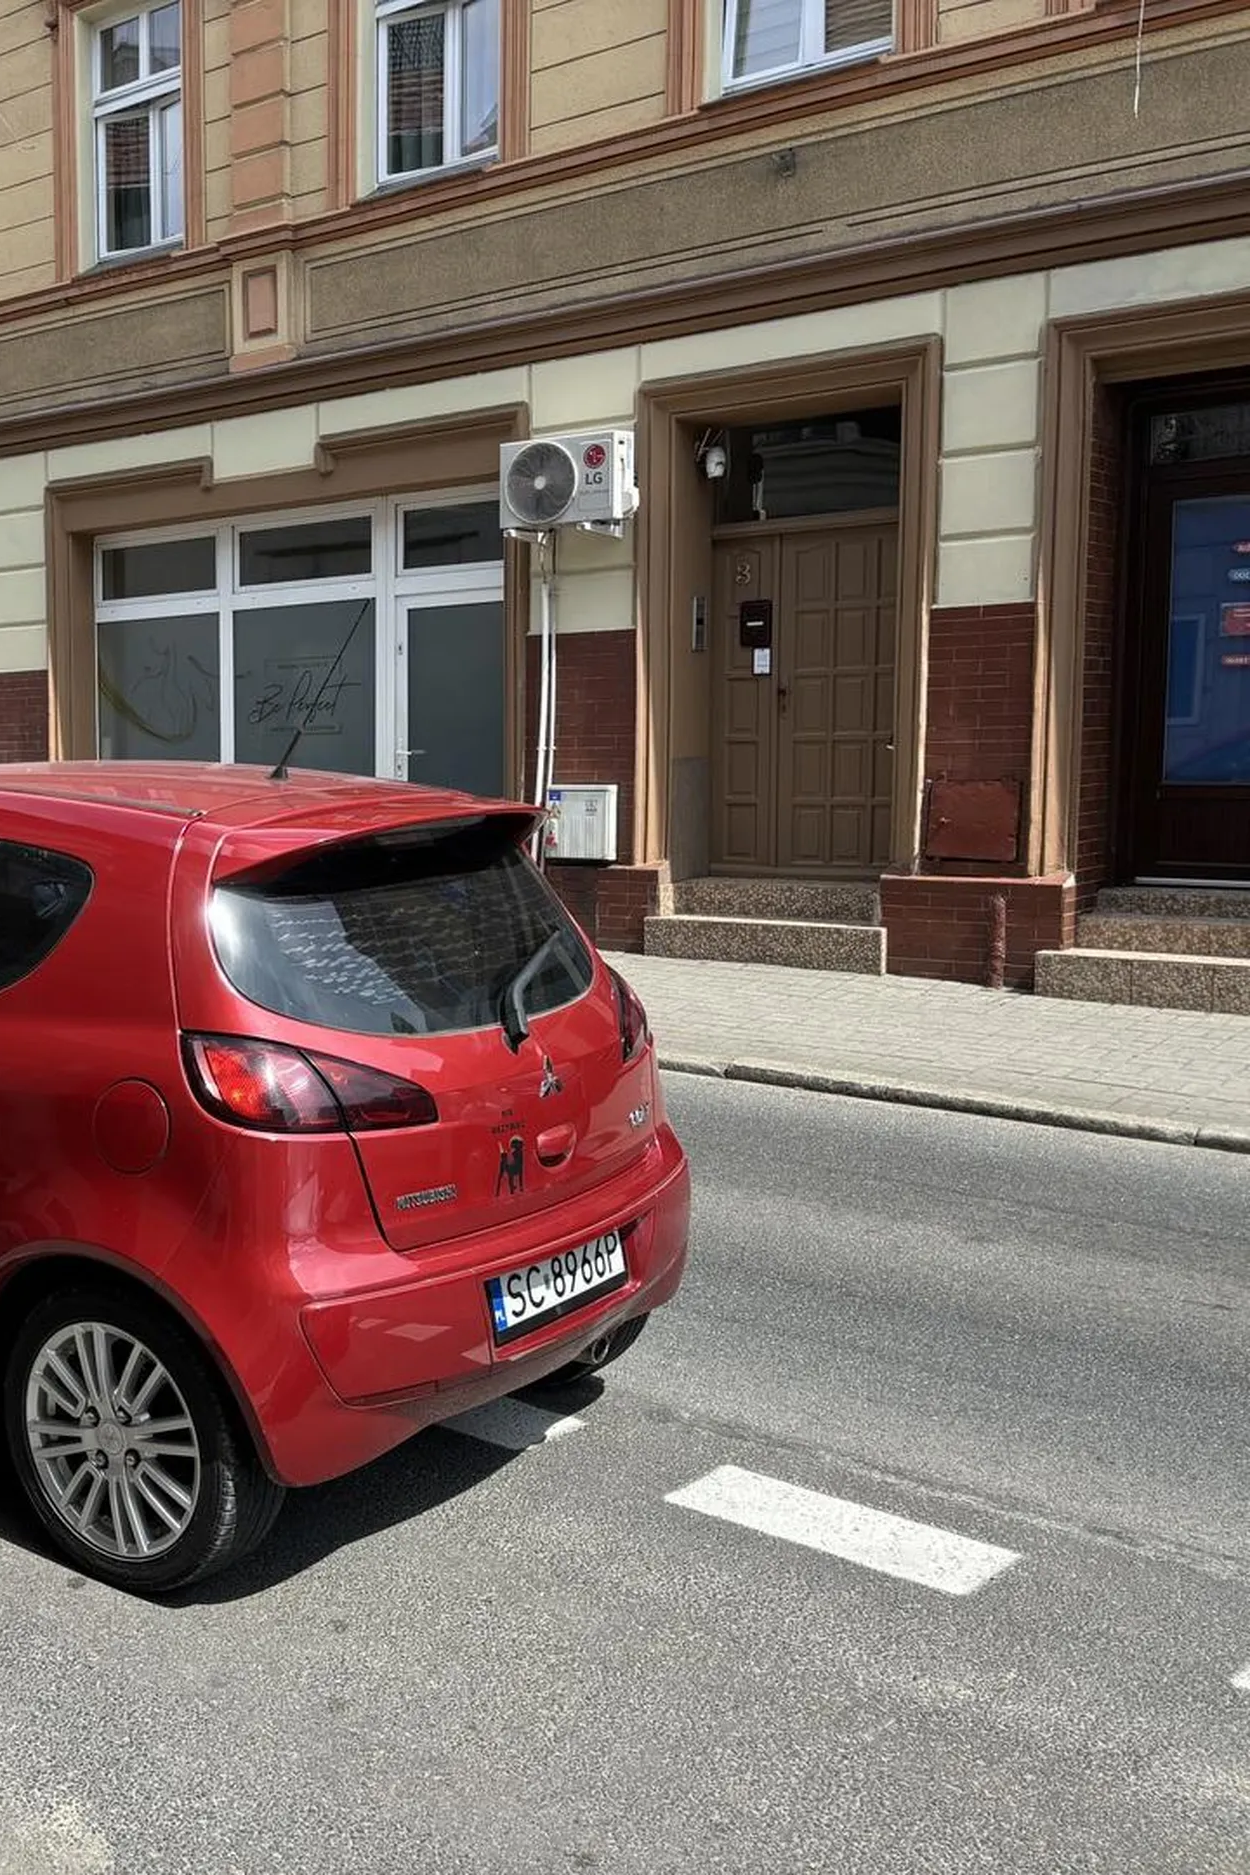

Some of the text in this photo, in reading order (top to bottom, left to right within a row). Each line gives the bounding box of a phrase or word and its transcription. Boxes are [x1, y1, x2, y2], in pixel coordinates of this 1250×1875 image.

[585, 471, 604, 486] LG
[736, 563, 751, 585] 3
[507, 1232, 618, 1318] SC 8966P
